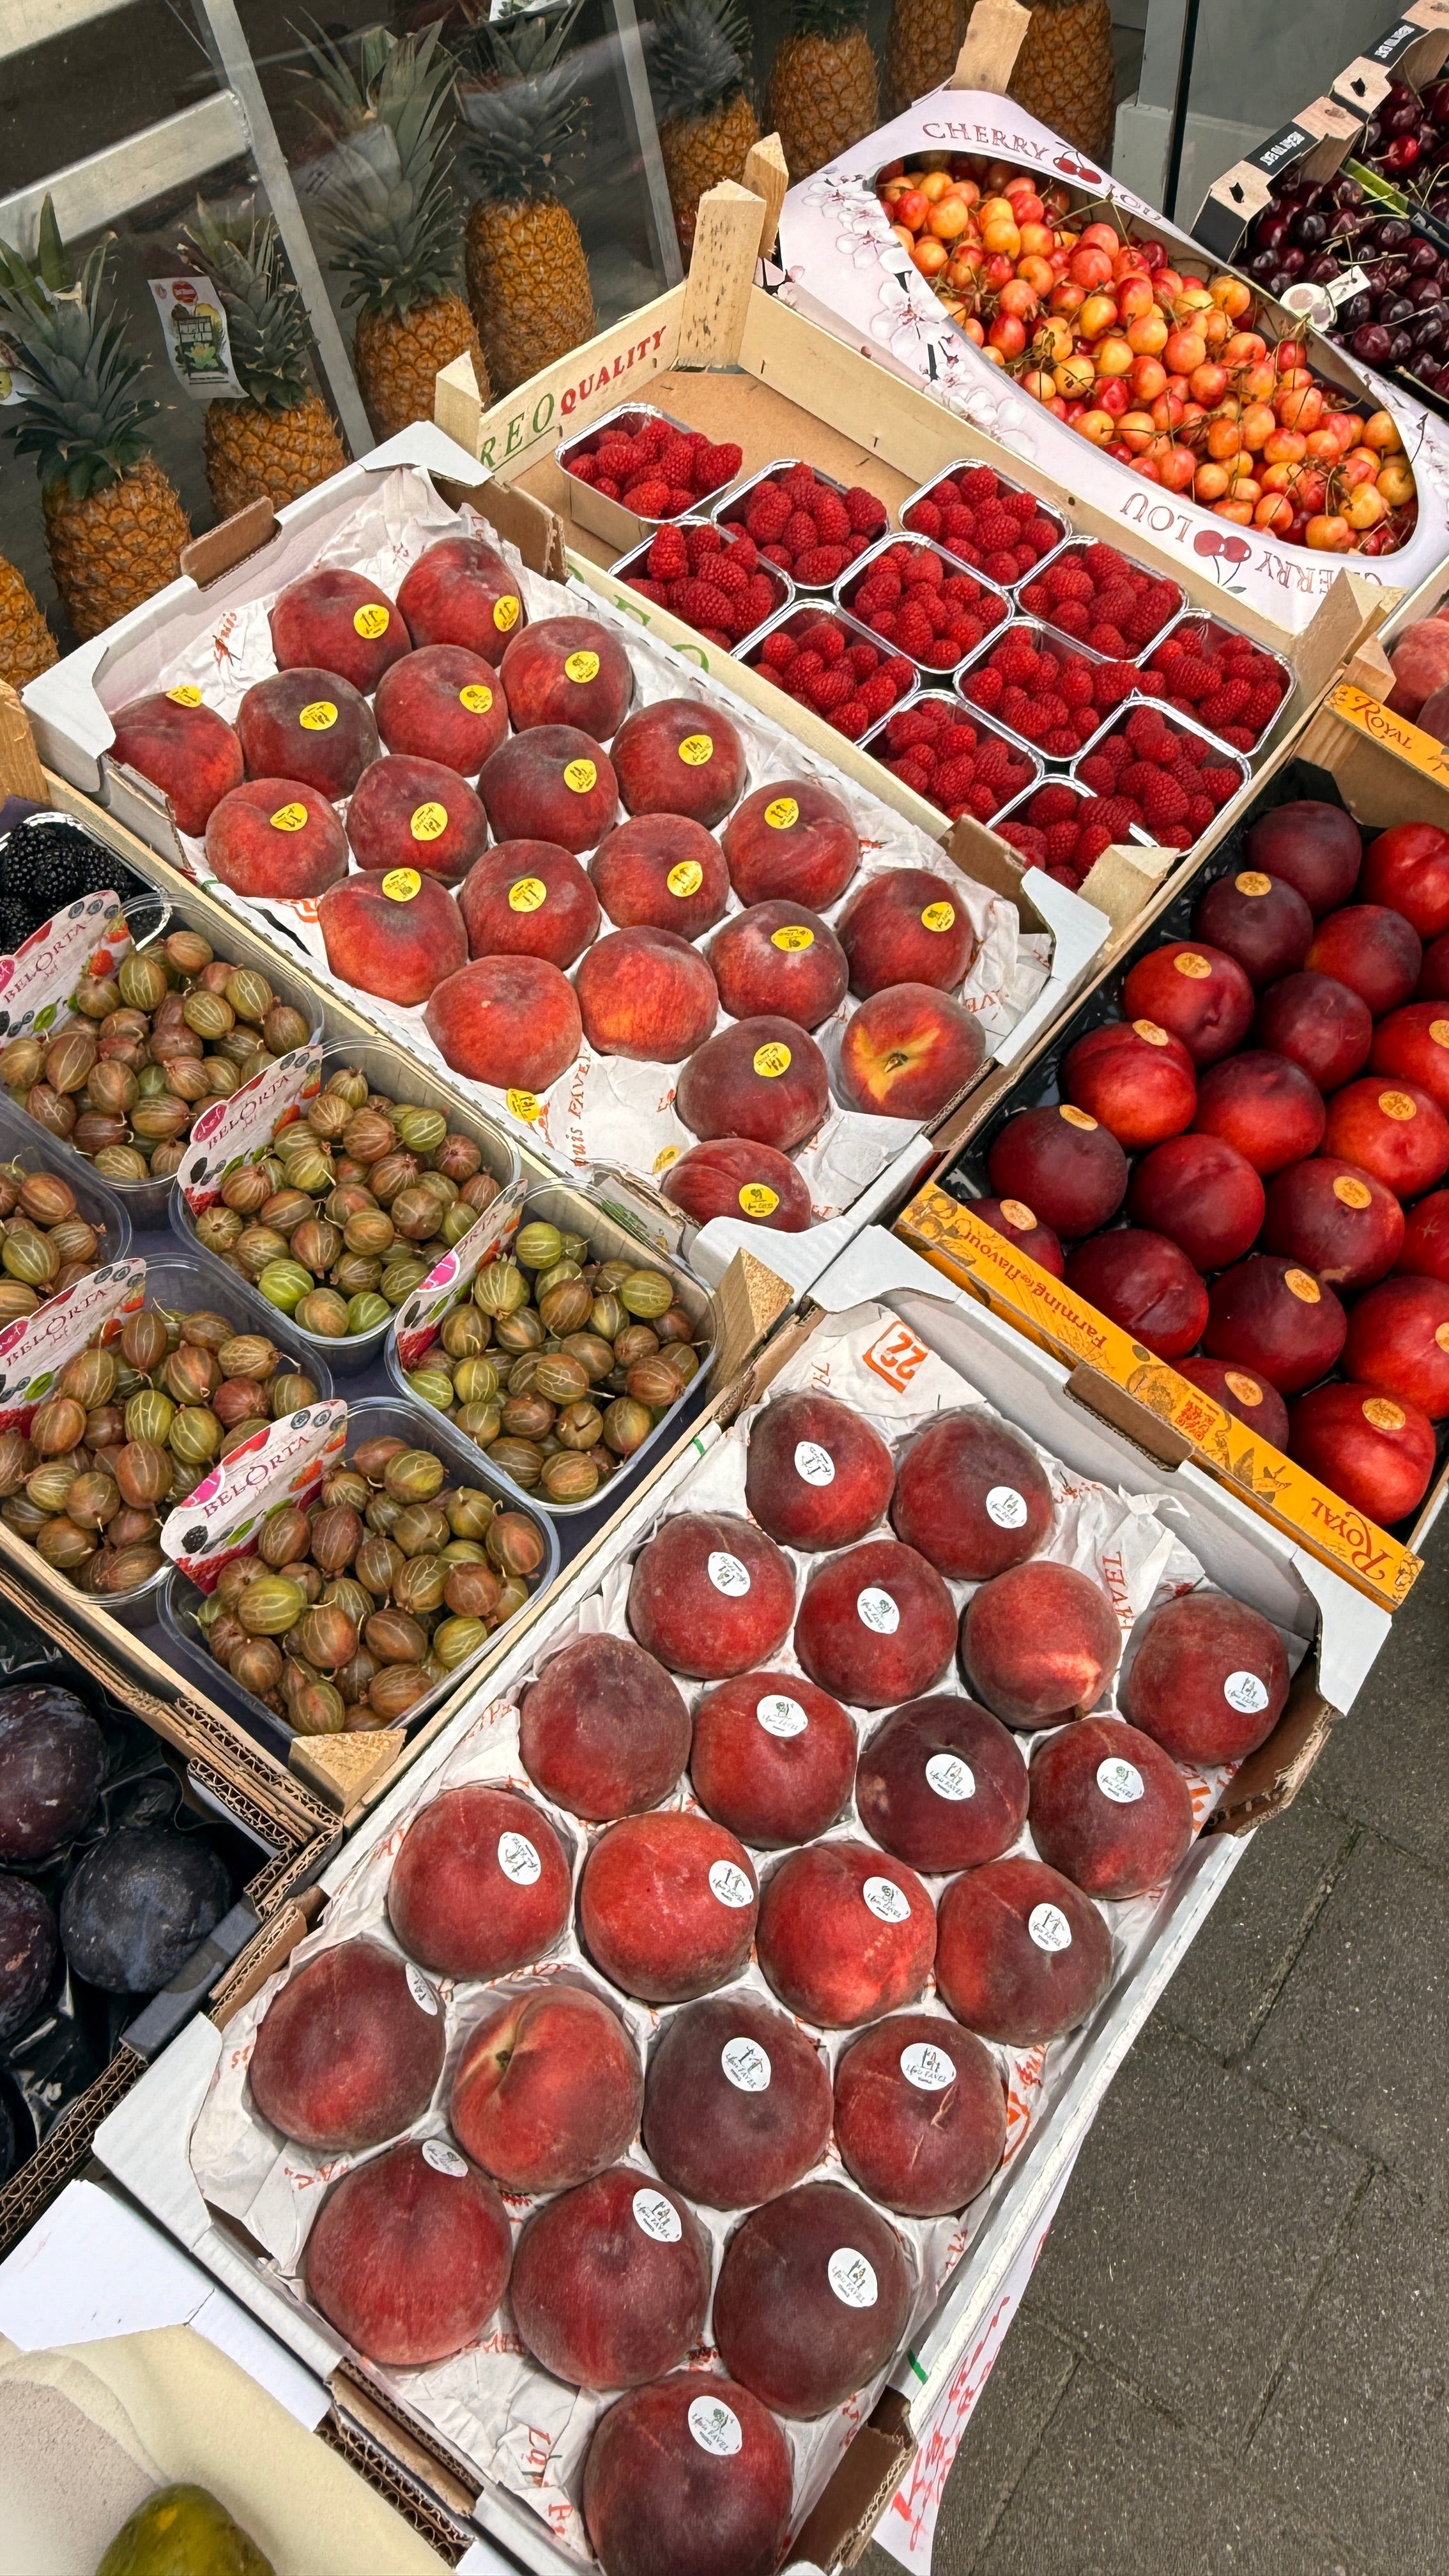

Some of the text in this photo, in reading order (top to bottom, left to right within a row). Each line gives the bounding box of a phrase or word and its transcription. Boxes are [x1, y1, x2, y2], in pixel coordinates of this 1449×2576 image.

[922, 122, 1050, 161] CHERRY
[480, 325, 667, 469] REO QUALITY
[1120, 492, 1193, 543] LOU
[1348, 695, 1412, 749] ROYAL
[3, 923, 87, 1004] BELORTA
[207, 1075, 289, 1151] BELORTA
[6, 1289, 107, 1368] BELORTA
[958, 1230, 1108, 1349] Farming for flavour
[880, 1331, 928, 1380] 22
[202, 1436, 310, 1519] BELORTA
[1311, 1496, 1394, 1580] ROYAL
